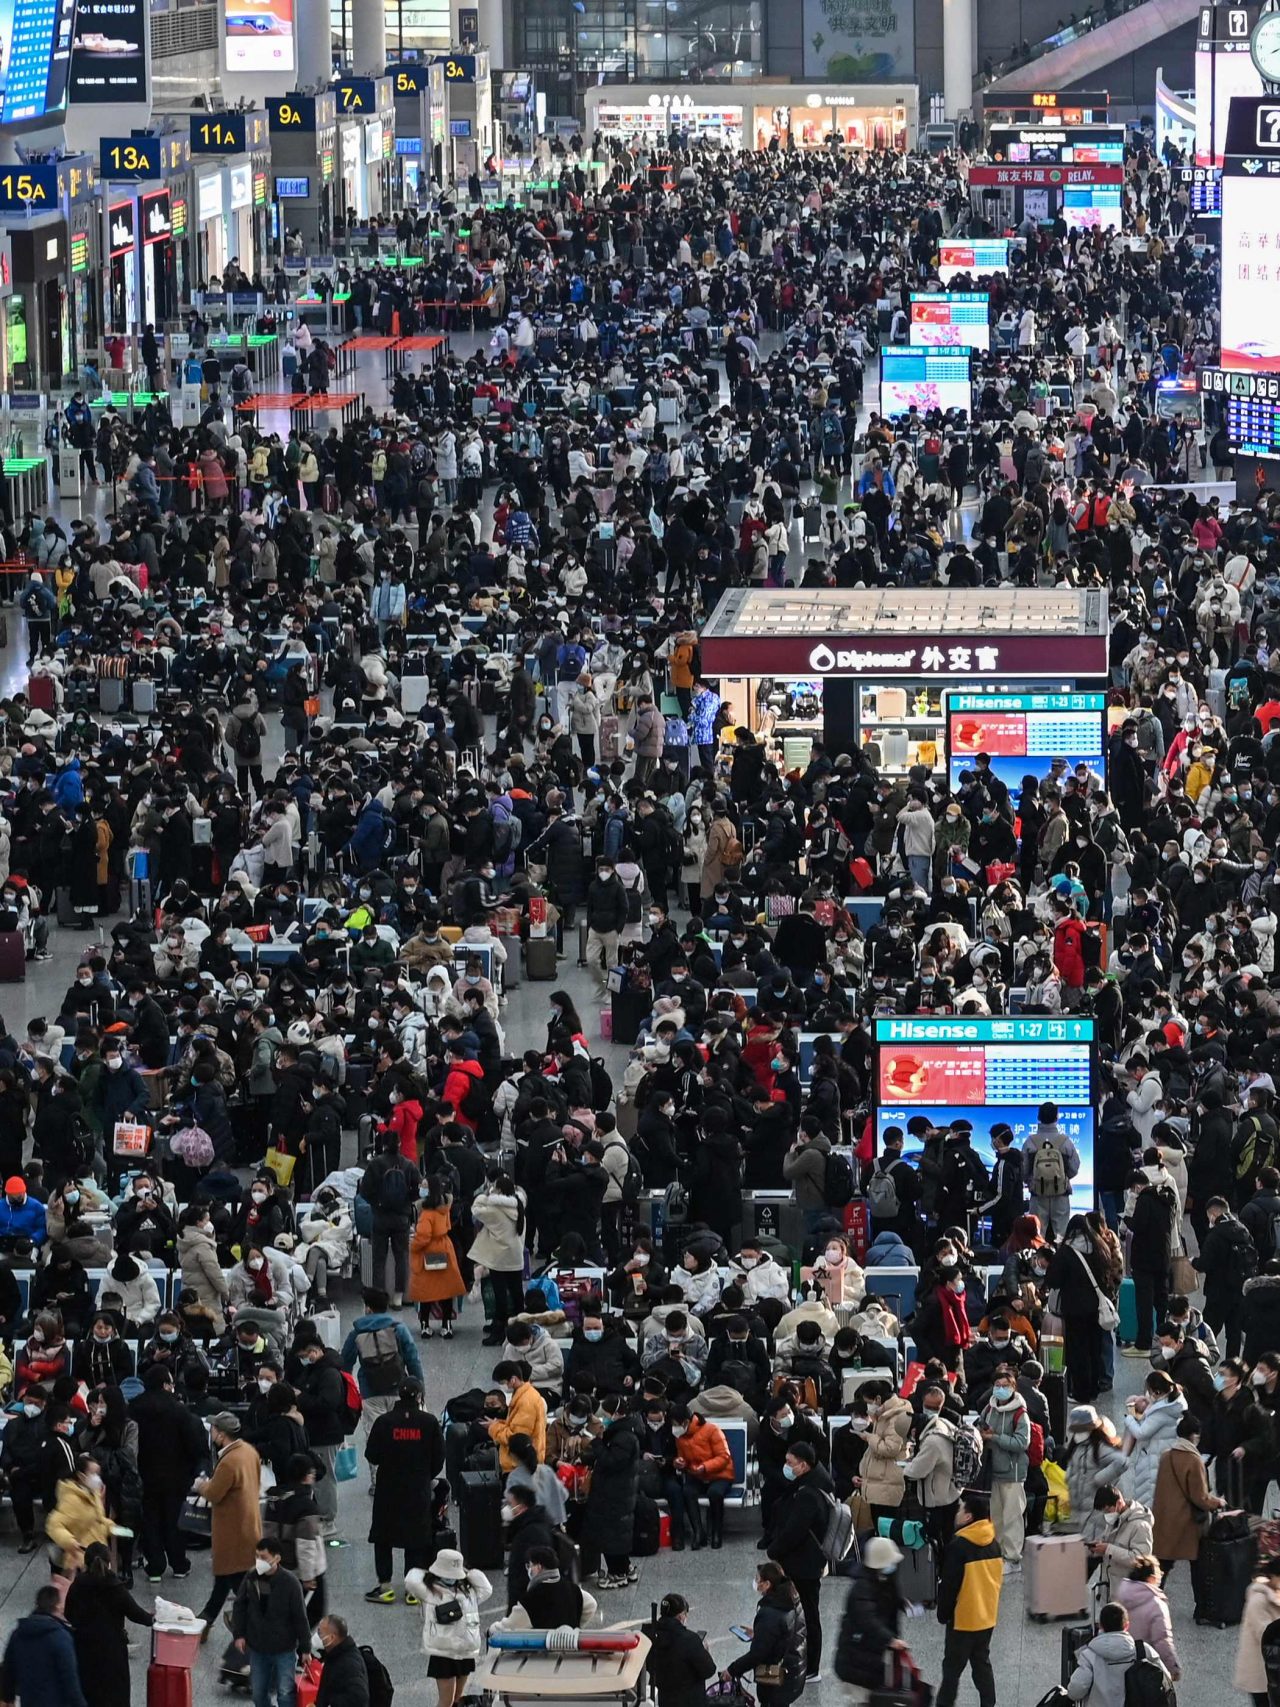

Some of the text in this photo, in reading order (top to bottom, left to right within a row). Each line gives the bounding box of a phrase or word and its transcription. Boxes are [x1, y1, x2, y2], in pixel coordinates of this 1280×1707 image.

[446, 62, 464, 77] 3A
[397, 74, 416, 91] 5A
[341, 88, 362, 107] 7A
[278, 105, 301, 124] 9A
[200, 124, 235, 145] 11A
[110, 147, 150, 169] 13A
[997, 170, 1045, 182] 旅友书屋
[2, 175, 46, 200] 15A
[921, 646, 999, 671] 外交官
[959, 695, 1022, 709] Hisense
[890, 1022, 978, 1038] Hisense
[1019, 1023, 1043, 1037] 1-27
[881, 1112, 905, 1120] BYD
[393, 1428, 421, 1440] CHINA
